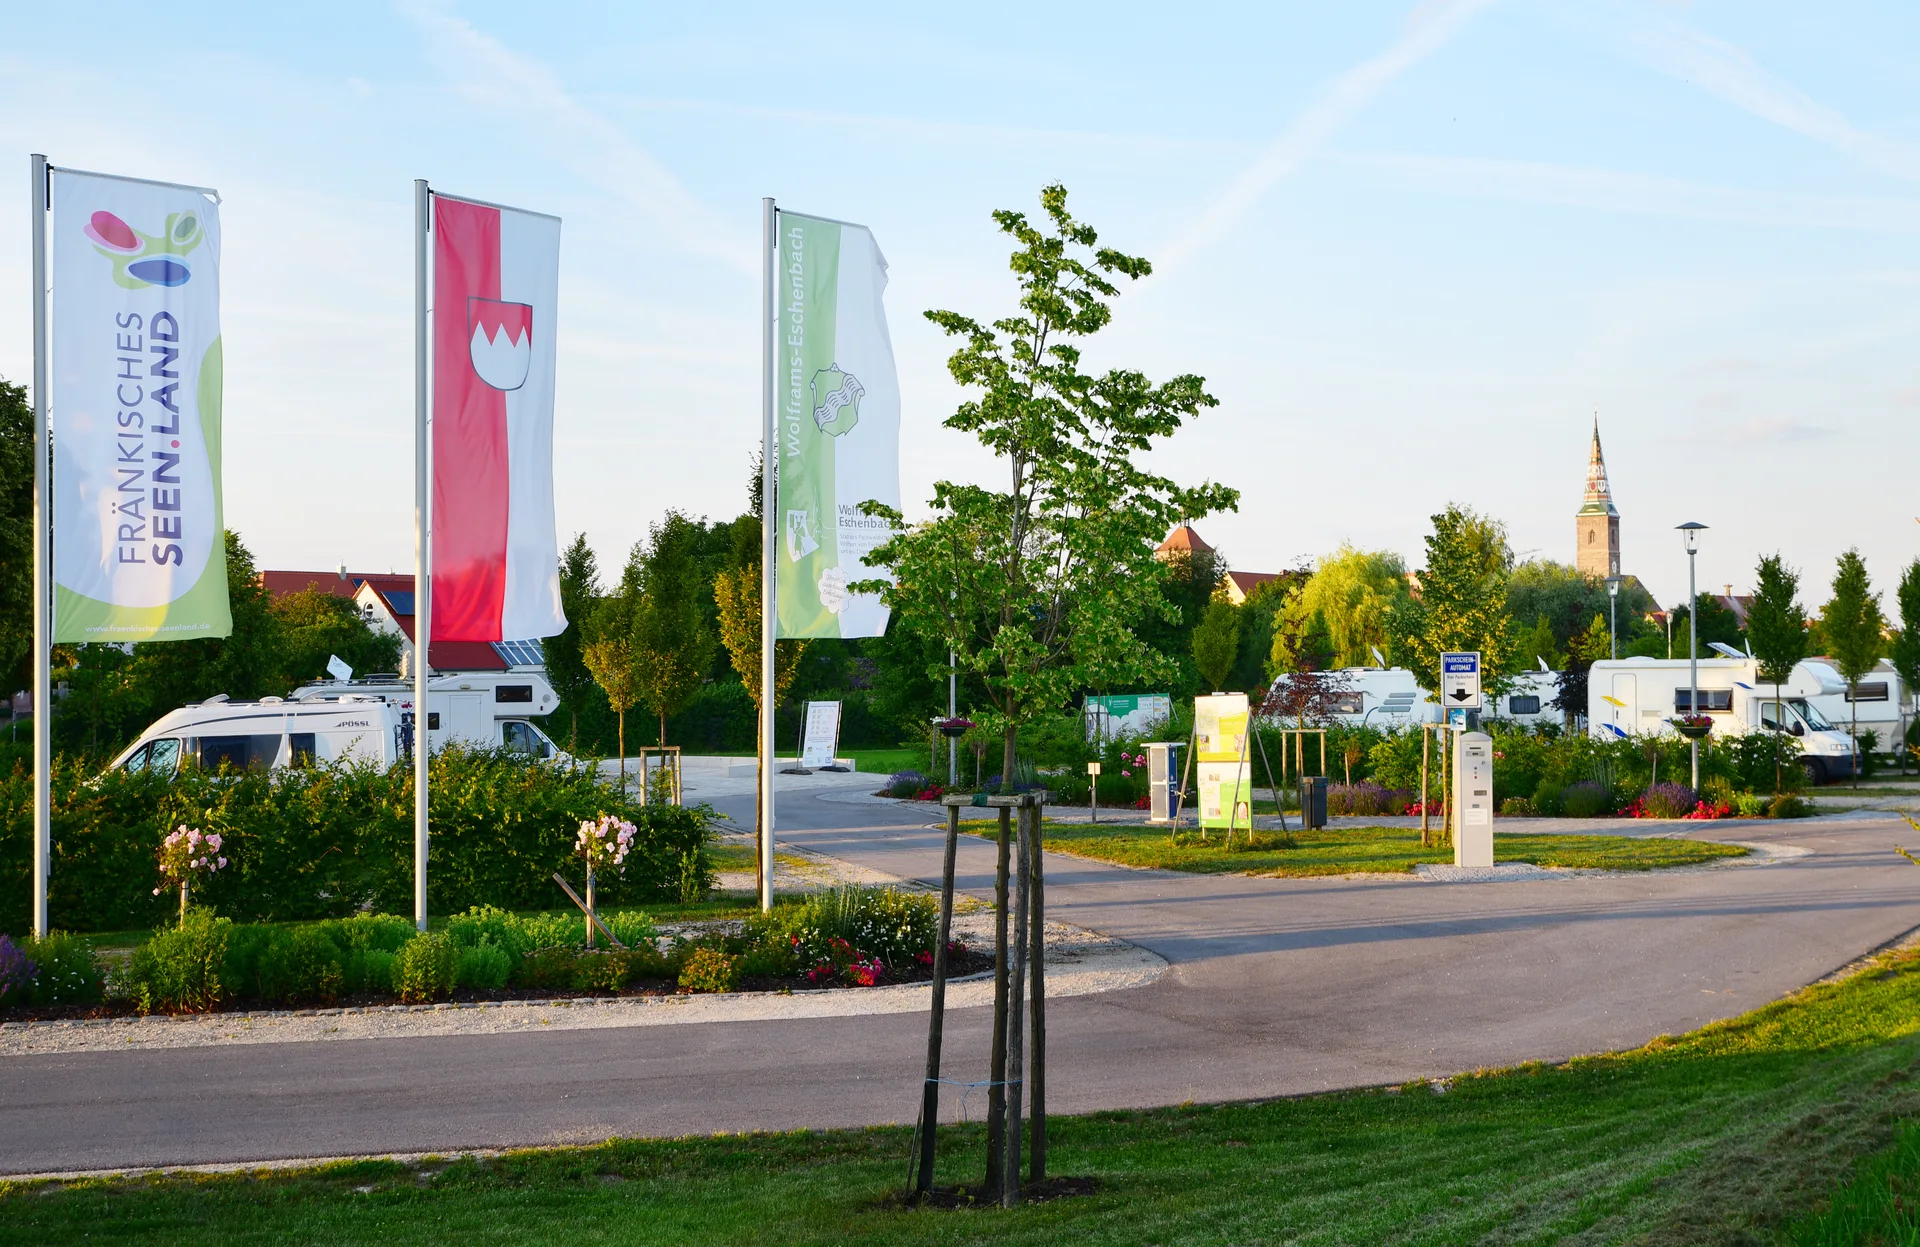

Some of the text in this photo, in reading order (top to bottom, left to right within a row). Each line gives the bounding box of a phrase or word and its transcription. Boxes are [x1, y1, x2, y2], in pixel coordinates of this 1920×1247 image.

[787, 227, 804, 458] Wolframs-Eschenbach
[111, 312, 146, 564] FRÄNKISCHES
[150, 311, 183, 567] SEEN.LAND
[839, 516, 890, 529] Eschenbac
[85, 623, 210, 633] www.fraenkisches-seenland.de
[342, 720, 370, 728] PÖSSL
